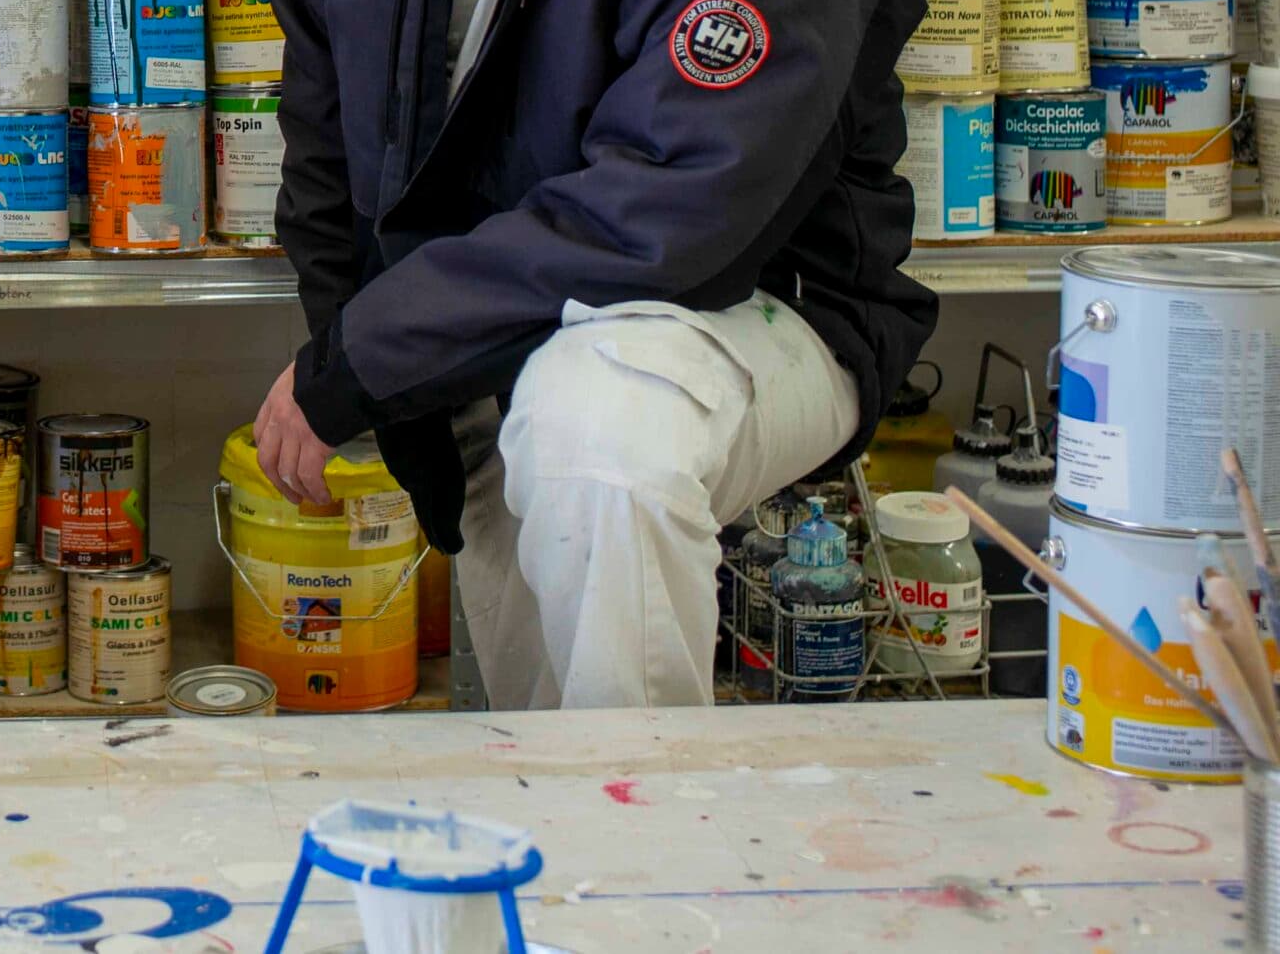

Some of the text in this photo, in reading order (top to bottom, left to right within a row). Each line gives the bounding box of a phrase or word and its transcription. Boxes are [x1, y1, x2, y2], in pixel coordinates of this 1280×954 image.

[959, 11, 981, 20] Nova
[1055, 10, 1075, 18] Nova
[697, 0, 736, 12] EXTREME
[737, 6, 764, 49] CONDITIONS
[681, 58, 711, 81] HANSEN
[714, 58, 756, 82] WORKWEAR
[1027, 105, 1084, 118] Capalac
[235, 118, 262, 131] Spin
[1006, 119, 1100, 133] Dickschichtlack
[1125, 118, 1171, 127] CAPAROL
[60, 454, 134, 472] sikkens
[287, 573, 352, 587] RenoTech
[108, 592, 164, 607] Oellasur
[92, 617, 131, 630] SAMI
